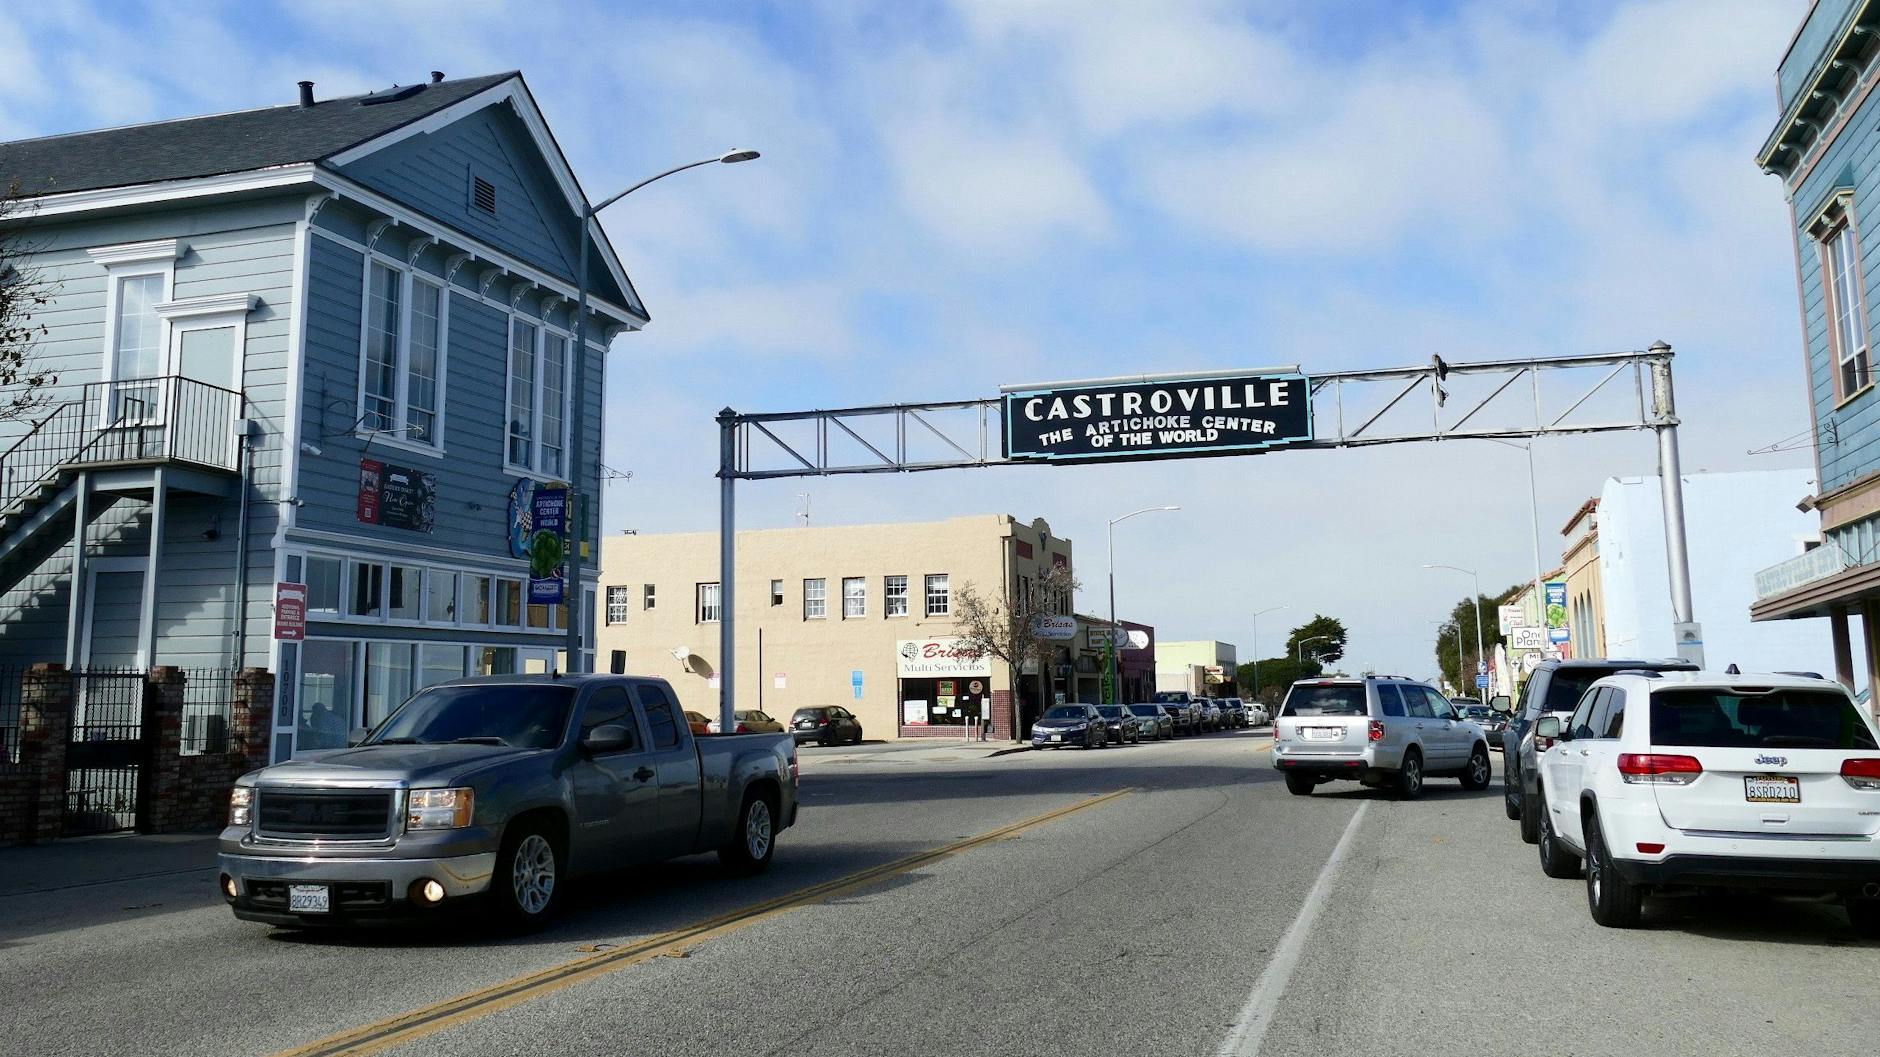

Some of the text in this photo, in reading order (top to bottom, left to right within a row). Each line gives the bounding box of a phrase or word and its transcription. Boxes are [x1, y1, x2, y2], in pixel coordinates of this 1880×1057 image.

[1024, 381, 1289, 421] CASTROVILLE
[1039, 415, 1276, 446] THE ARTICHOKE CENTER
[1091, 428, 1218, 448] OF THE WORLD
[536, 500, 564, 508] ARTICHOKE
[539, 507, 559, 516] CENTER
[540, 519, 558, 527] WORLD
[1043, 619, 1073, 628] Brisas
[904, 662, 985, 672] Multi Servicios
[1754, 753, 1788, 767] Jeep
[1749, 786, 1796, 798] 8SRD210
